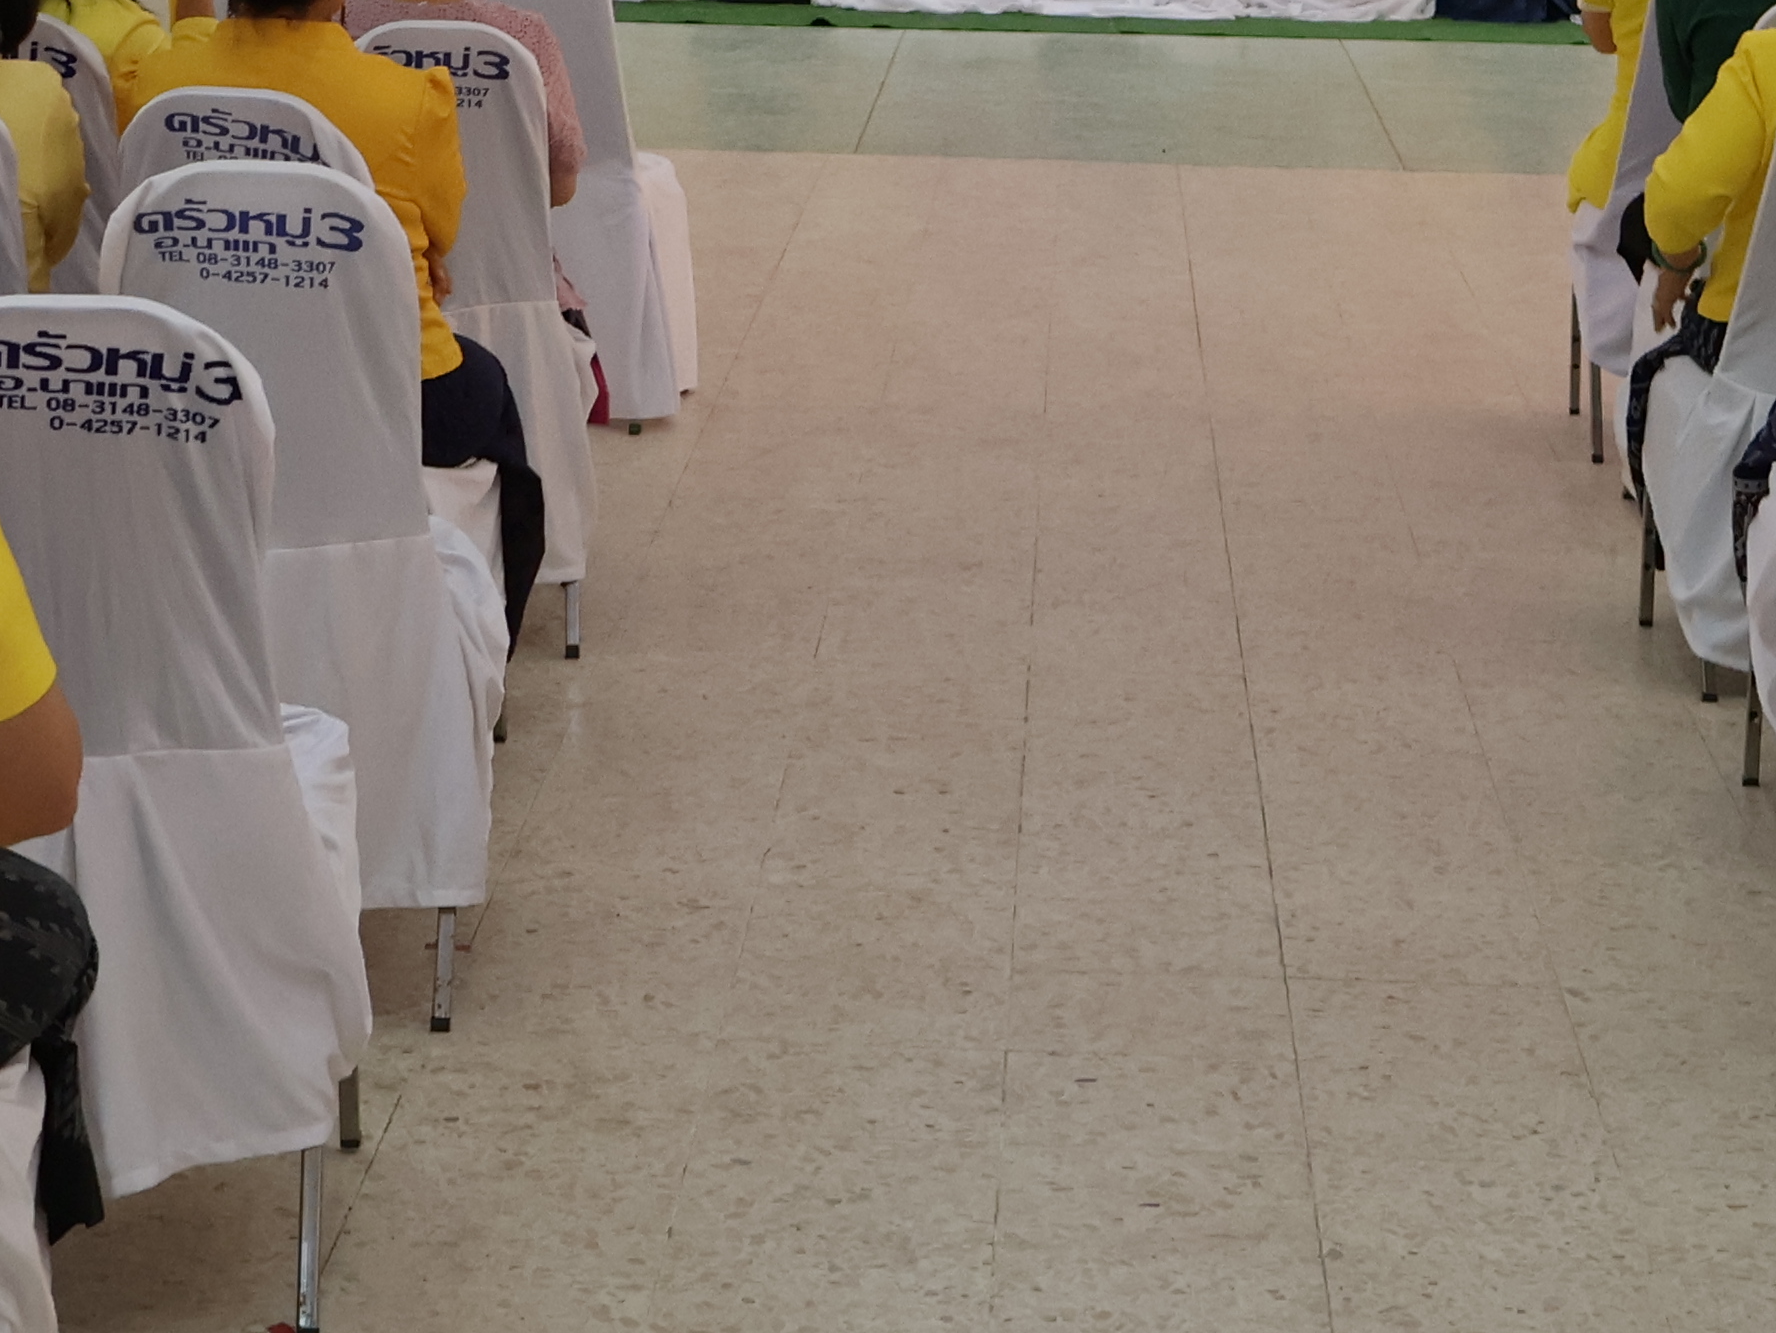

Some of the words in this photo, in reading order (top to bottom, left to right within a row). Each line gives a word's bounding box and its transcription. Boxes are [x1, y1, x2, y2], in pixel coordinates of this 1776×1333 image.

[196, 252, 336, 274] 08-3148-3307
[200, 267, 330, 289] 0-4257-1214
[46, 397, 221, 428] 08-3148-3307
[50, 416, 208, 444] 0-4257-1214
